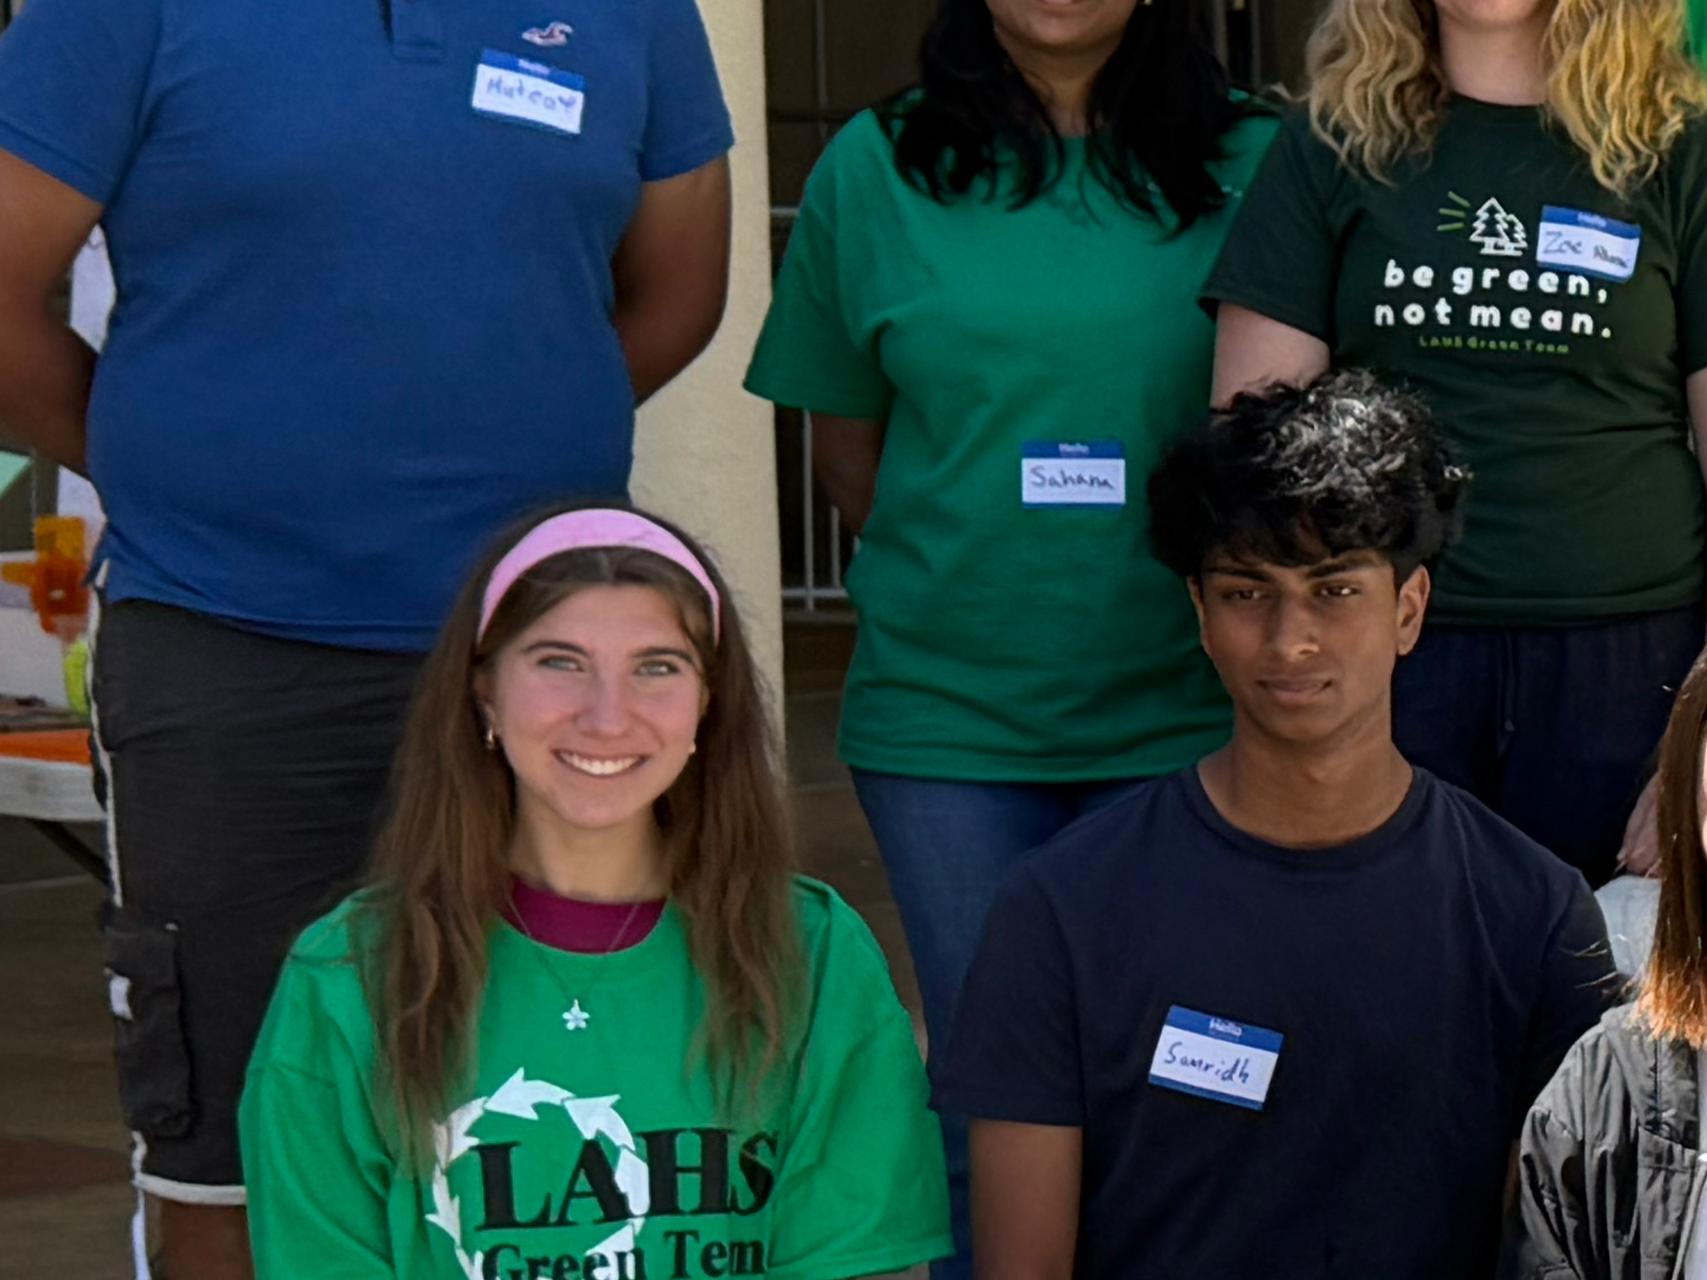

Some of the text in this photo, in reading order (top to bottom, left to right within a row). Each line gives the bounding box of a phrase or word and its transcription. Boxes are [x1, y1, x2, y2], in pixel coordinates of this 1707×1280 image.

[1384, 259, 1434, 288] be
[1374, 297, 1612, 339] not mean.
[1030, 465, 1115, 490] Sahana
[470, 1127, 780, 1232] LAHS
